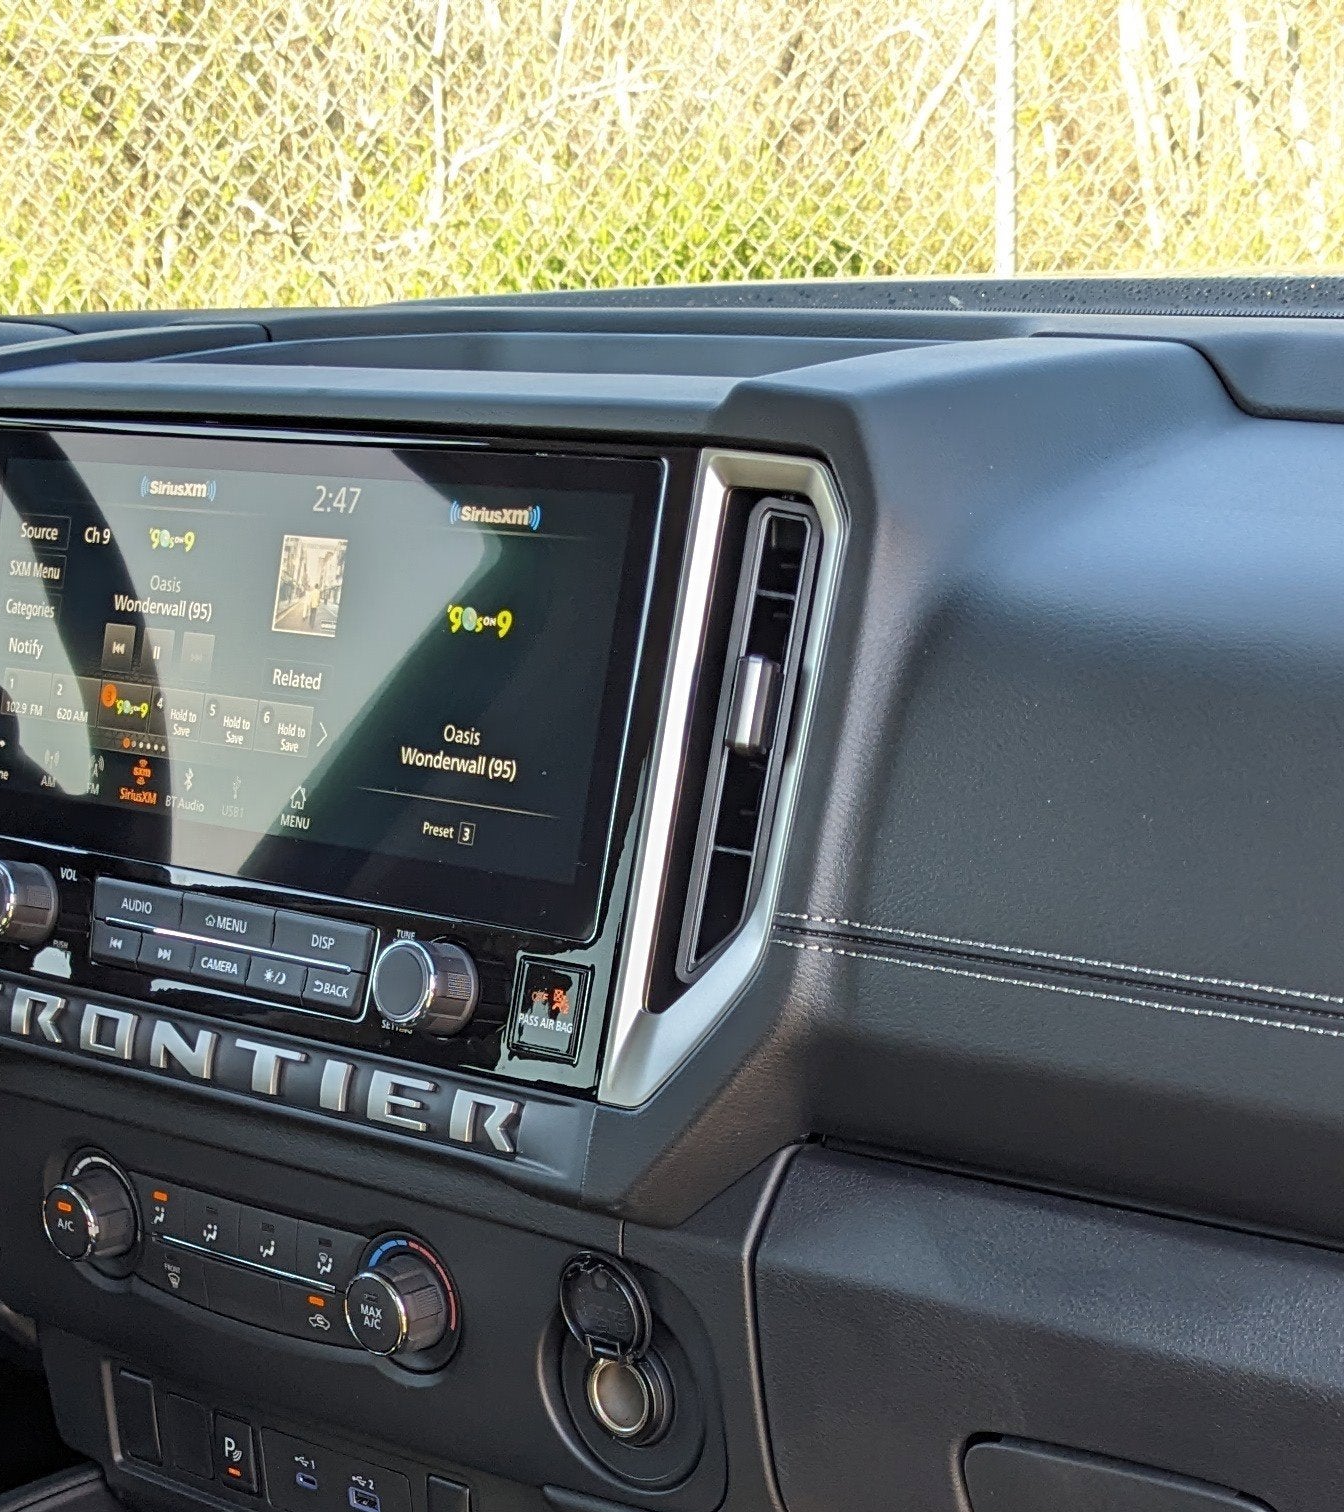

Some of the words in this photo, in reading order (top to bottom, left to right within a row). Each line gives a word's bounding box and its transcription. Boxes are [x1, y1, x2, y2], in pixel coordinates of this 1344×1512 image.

[312, 485, 362, 514] 2:47
[21, 522, 58, 541] Source
[85, 527, 100, 544] Ch
[102, 528, 111, 545] 9
[9, 560, 31, 578] SXM
[33, 562, 60, 580] Menu
[150, 575, 181, 593] Oasis
[6, 598, 55, 620] Categories
[114, 594, 186, 618] Wonderwall
[188, 600, 212, 622] (95)
[8, 637, 44, 659] Notify
[273, 668, 322, 690] Related
[57, 684, 63, 696] 2
[6, 701, 27, 714] 102.9
[30, 704, 43, 717] FM
[157, 697, 164, 709] 4
[210, 704, 216, 716] 5
[57, 708, 72, 721] 620
[73, 710, 88, 723] AM
[170, 708, 188, 722] Hold
[188, 710, 197, 723] to
[223, 716, 241, 729] Hold
[242, 718, 251, 730] to
[264, 711, 270, 723] 6
[173, 723, 190, 738] Save
[226, 731, 244, 745] Save
[277, 723, 296, 737] Hold
[298, 725, 306, 738] to
[444, 724, 480, 746] Oasis
[280, 739, 299, 753] Save
[401, 746, 486, 775] Wonderwall
[488, 757, 517, 782] (95)
[40, 775, 56, 788] AM
[87, 782, 100, 795] FM
[120, 787, 157, 805] SiriusXM
[166, 795, 177, 808] BT
[178, 798, 205, 813] Audio
[221, 804, 245, 818] USB1
[280, 813, 311, 830] MENU
[422, 822, 454, 839] Preset
[462, 828, 470, 842] 3
[60, 867, 78, 882] VOL
[121, 898, 153, 915] AUDIO
[216, 917, 247, 934] MENU
[312, 934, 335, 950] DISP
[396, 929, 416, 940] TUNE
[201, 957, 238, 975] CAMERA
[324, 983, 349, 999] BACK
[518, 1013, 539, 1027] PASS
[540, 1018, 555, 1030] AIR
[556, 1021, 574, 1034] BAG
[58, 1218, 75, 1232] A/C
[360, 1304, 383, 1320] MAX
[364, 1316, 381, 1330] A/C
[224, 1437, 236, 1457] P
[311, 1460, 316, 1470] 1
[368, 1479, 375, 1490] 2
